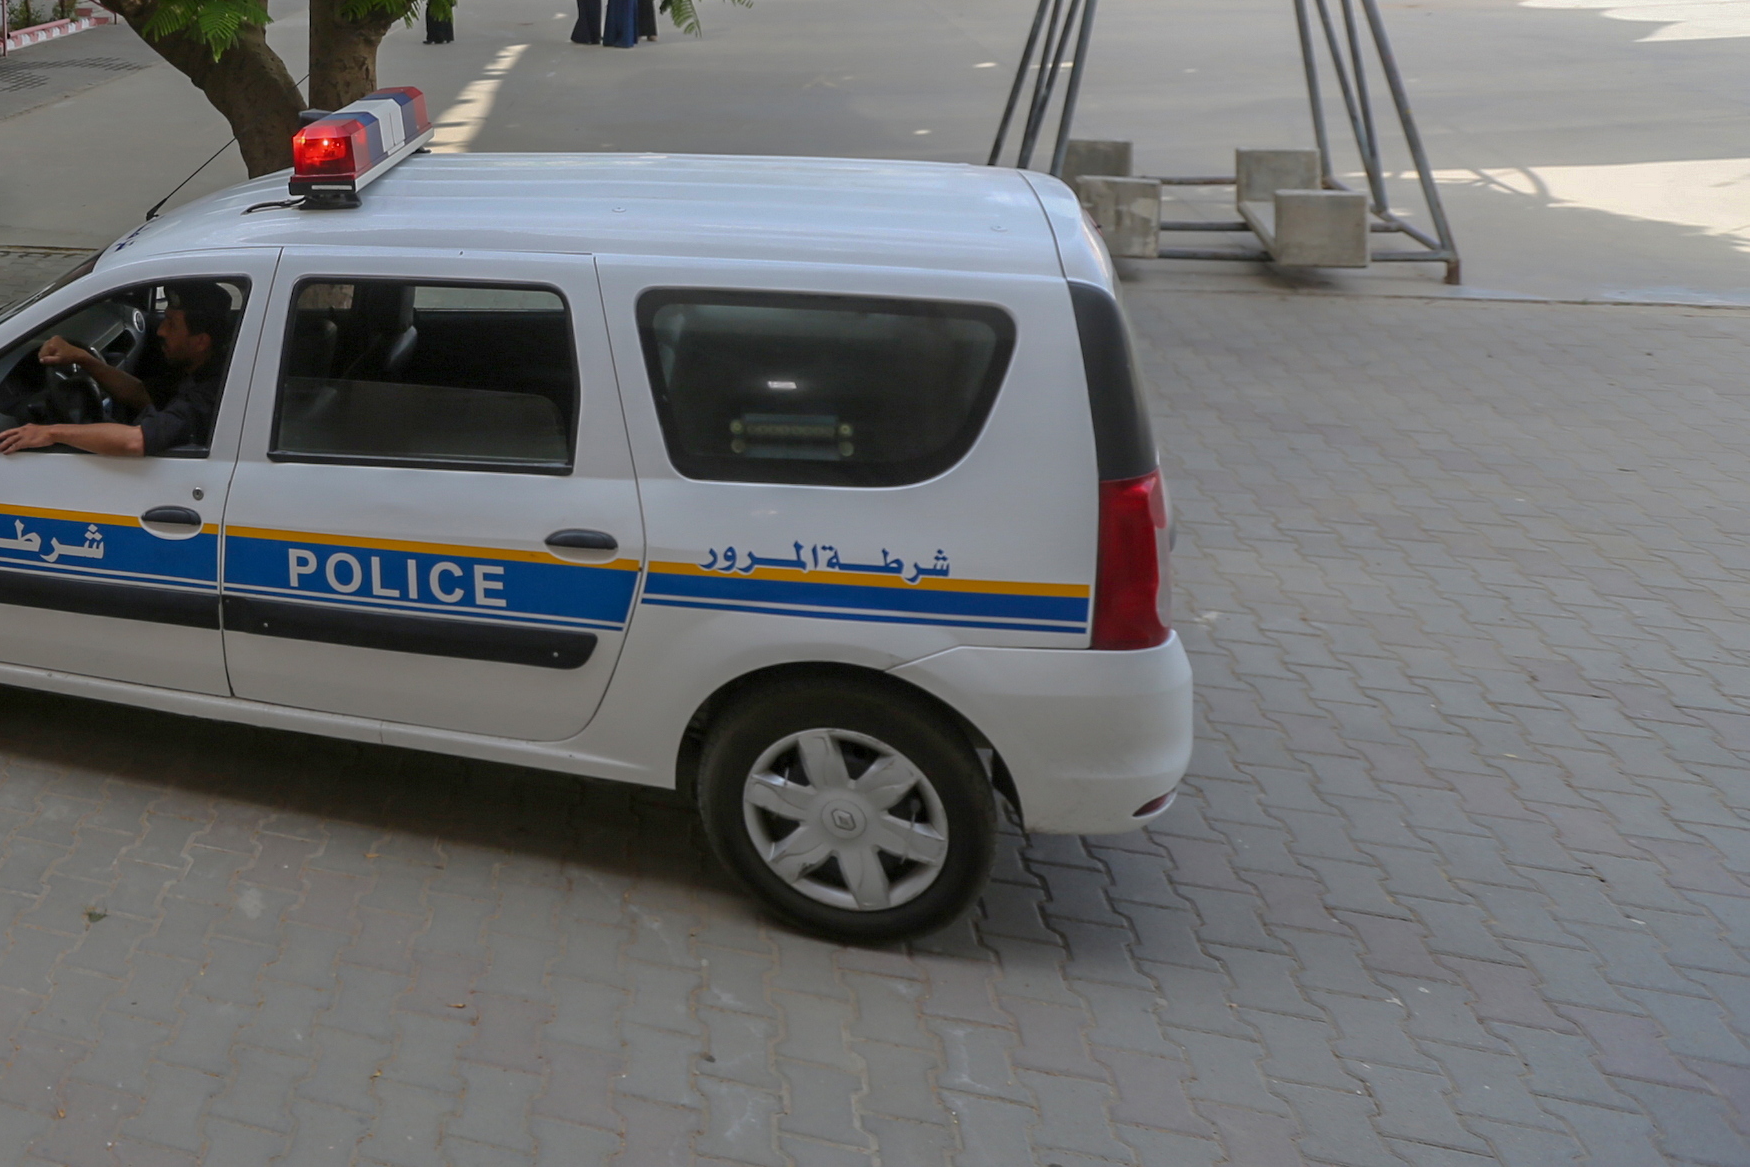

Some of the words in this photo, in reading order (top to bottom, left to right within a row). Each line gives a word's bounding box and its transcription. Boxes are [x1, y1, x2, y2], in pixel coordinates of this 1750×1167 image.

[699, 540, 819, 574] المرور
[821, 544, 950, 584] شرطة
[288, 548, 507, 607] POLICE
